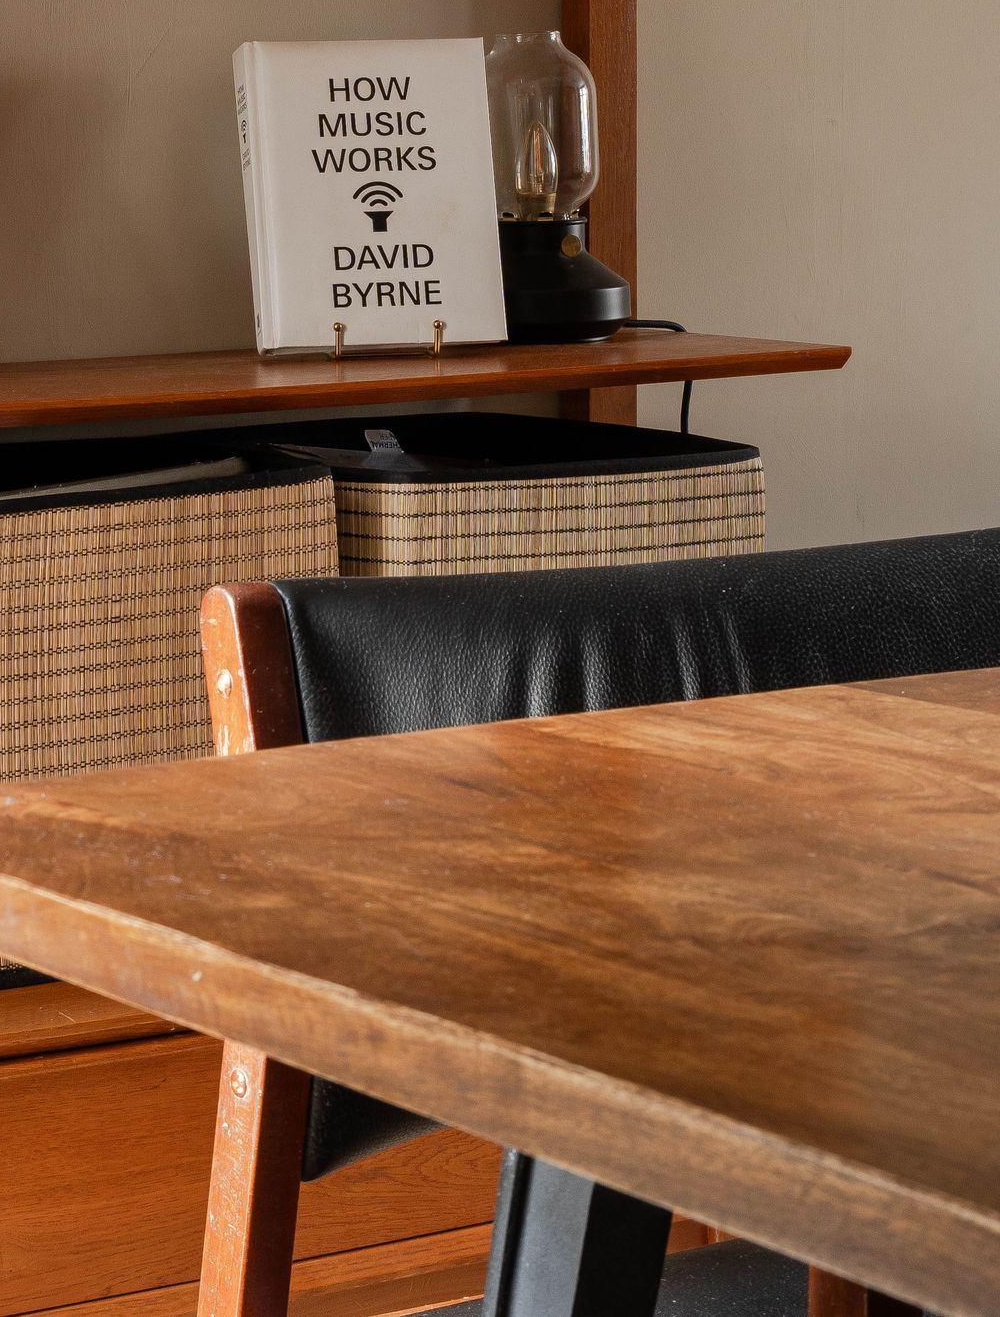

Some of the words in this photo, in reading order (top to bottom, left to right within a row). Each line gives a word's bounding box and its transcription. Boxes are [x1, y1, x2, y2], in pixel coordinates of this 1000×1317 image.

[328, 76, 411, 103] HOW
[317, 111, 427, 138] MUSIC
[311, 146, 437, 173] WORKS
[333, 244, 434, 271] DAVID
[332, 280, 443, 308] BYRNE
